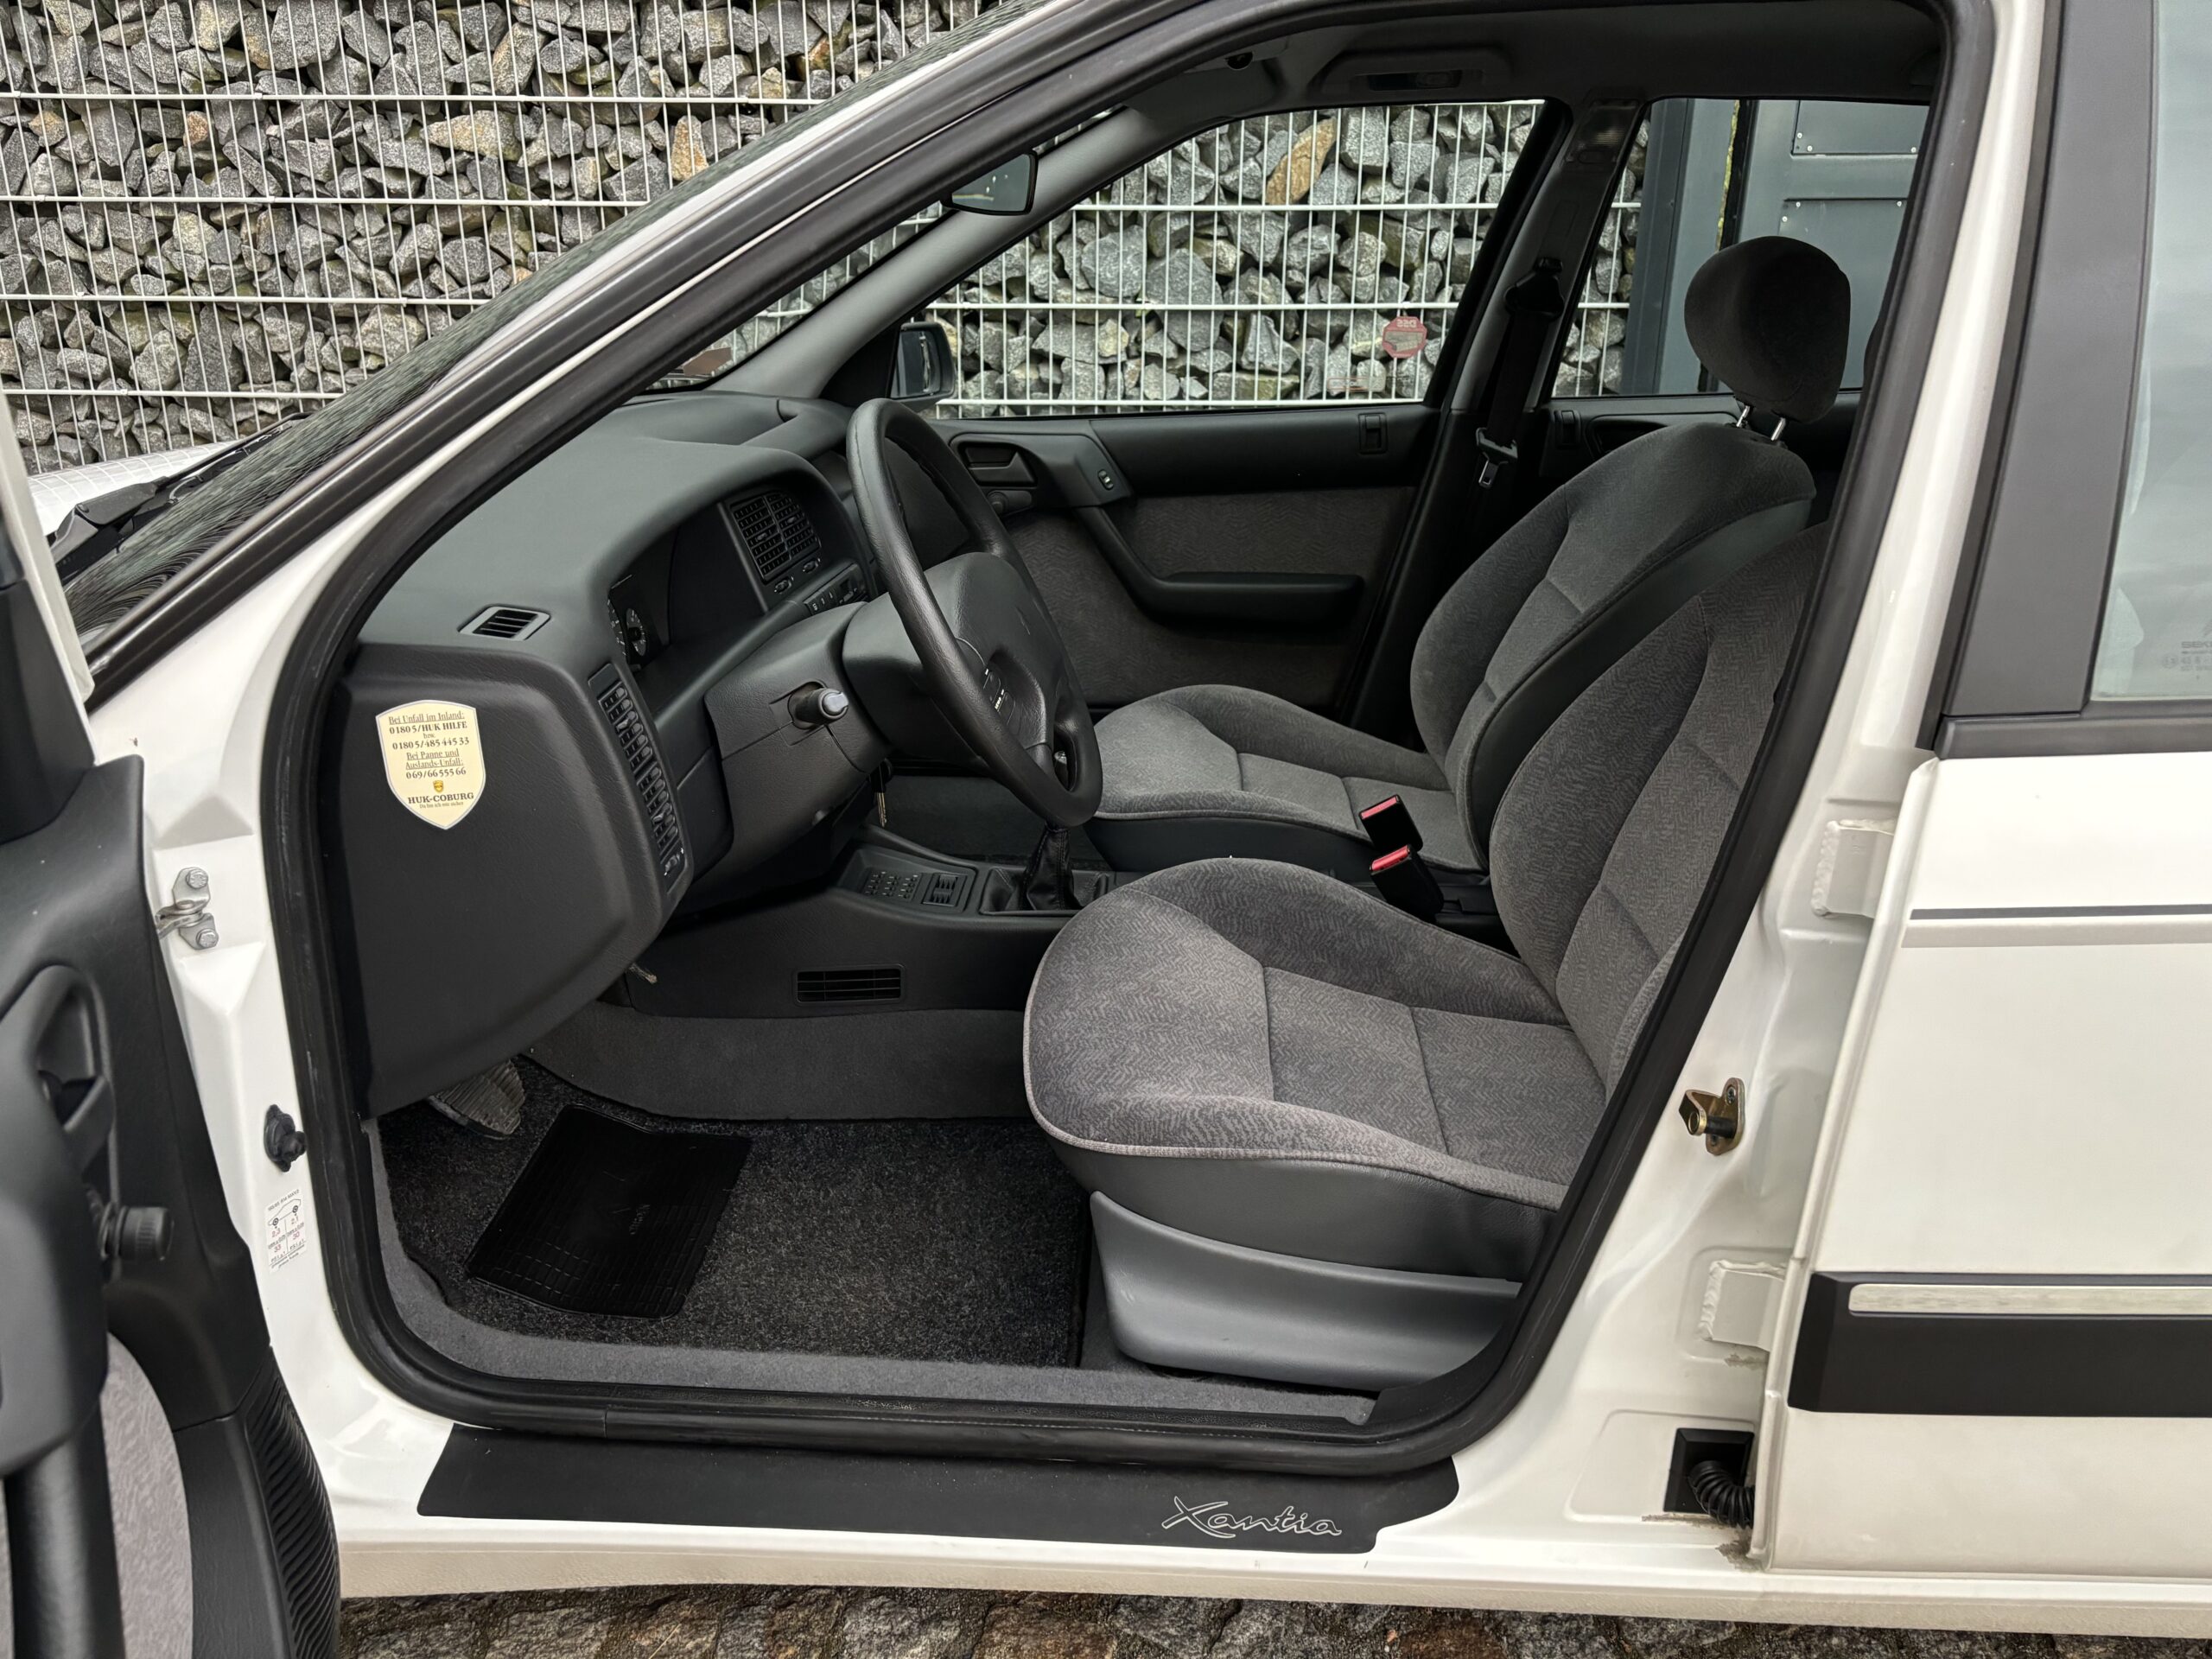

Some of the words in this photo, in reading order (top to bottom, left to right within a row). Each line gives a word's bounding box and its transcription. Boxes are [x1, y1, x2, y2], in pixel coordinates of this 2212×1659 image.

[388, 715, 401, 724] Bei
[403, 713, 424, 723] Unfall
[426, 713, 436, 721] im
[438, 710, 465, 721] Inland:
[442, 721, 467, 730] HILFE
[406, 752, 418, 760] Bei
[420, 750, 443, 760] Panne
[444, 748, 460, 758] und
[405, 757, 464, 770] Auslands-Unfall:
[408, 792, 474, 804] HUK-COBURG
[1161, 1496, 1342, 1538] Xantia
